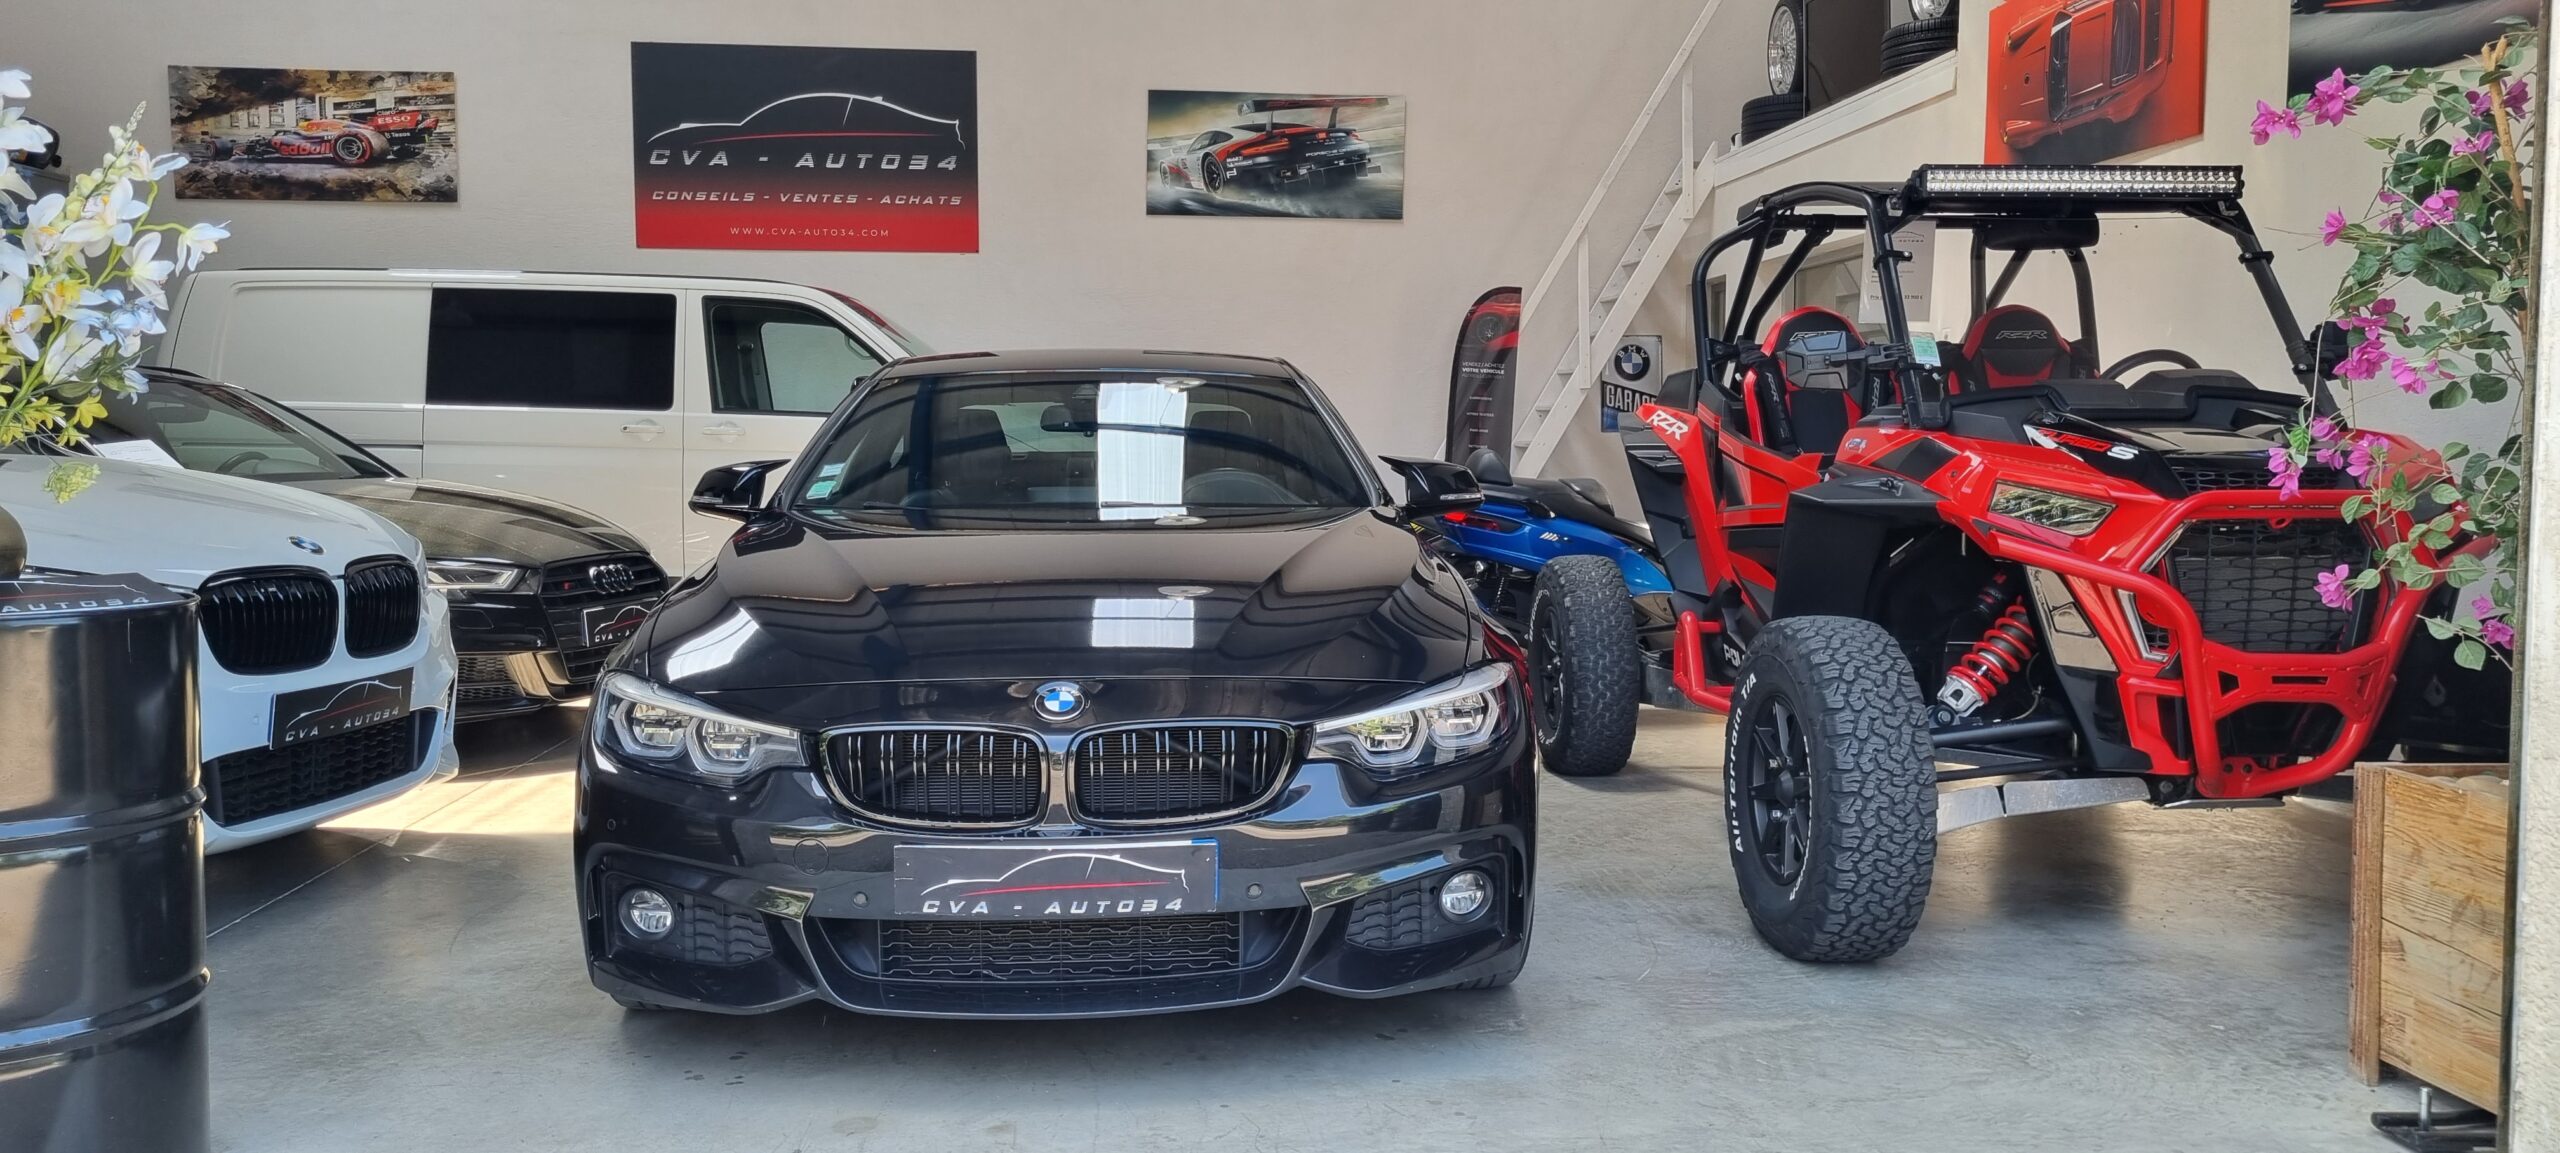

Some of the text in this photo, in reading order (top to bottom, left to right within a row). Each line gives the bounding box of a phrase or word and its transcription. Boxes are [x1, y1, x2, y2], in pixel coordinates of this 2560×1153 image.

[377, 115, 411, 125] ESSO
[649, 149, 729, 166] CVA
[794, 152, 957, 171] AUTO34
[652, 190, 755, 202] CONSEILS
[779, 193, 858, 204] VENTES
[880, 195, 963, 206] ACHATS
[730, 227, 889, 237] WWW.CVA-AUTO34.COM
[1995, 329, 2048, 340] RZR
[1618, 346, 1648, 358] BMW
[1646, 409, 1689, 441] RZR
[2107, 445, 2139, 460] S
[1, 597, 149, 613] AUTO34
[595, 633, 612, 642] CVA
[285, 726, 319, 742] CVA
[343, 706, 400, 729] AUTO34
[922, 900, 989, 914] CVA
[1044, 898, 1183, 914] AUTO34
